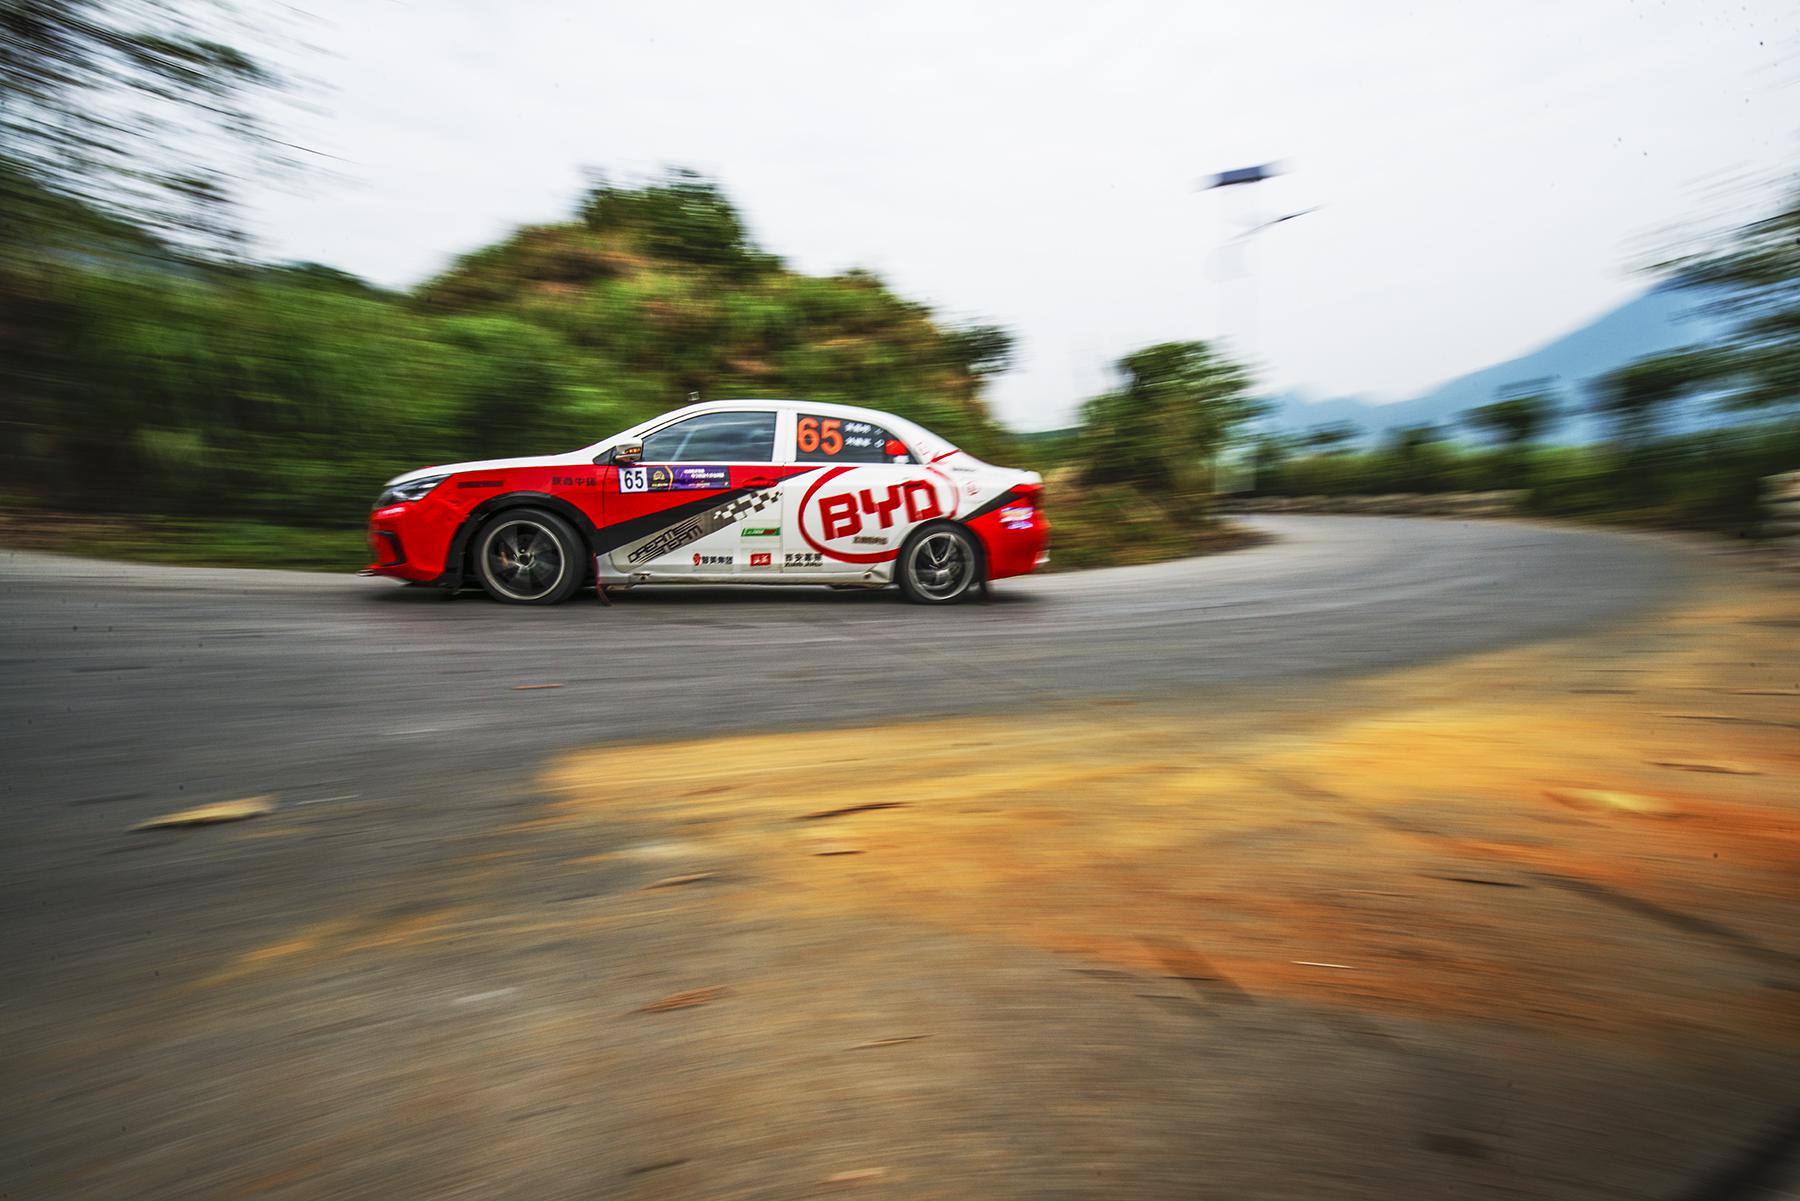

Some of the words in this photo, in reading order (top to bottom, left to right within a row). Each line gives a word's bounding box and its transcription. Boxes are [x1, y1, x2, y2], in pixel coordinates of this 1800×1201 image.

[797, 417, 844, 456] 65
[624, 470, 644, 489] 65
[818, 480, 944, 541] BYD
